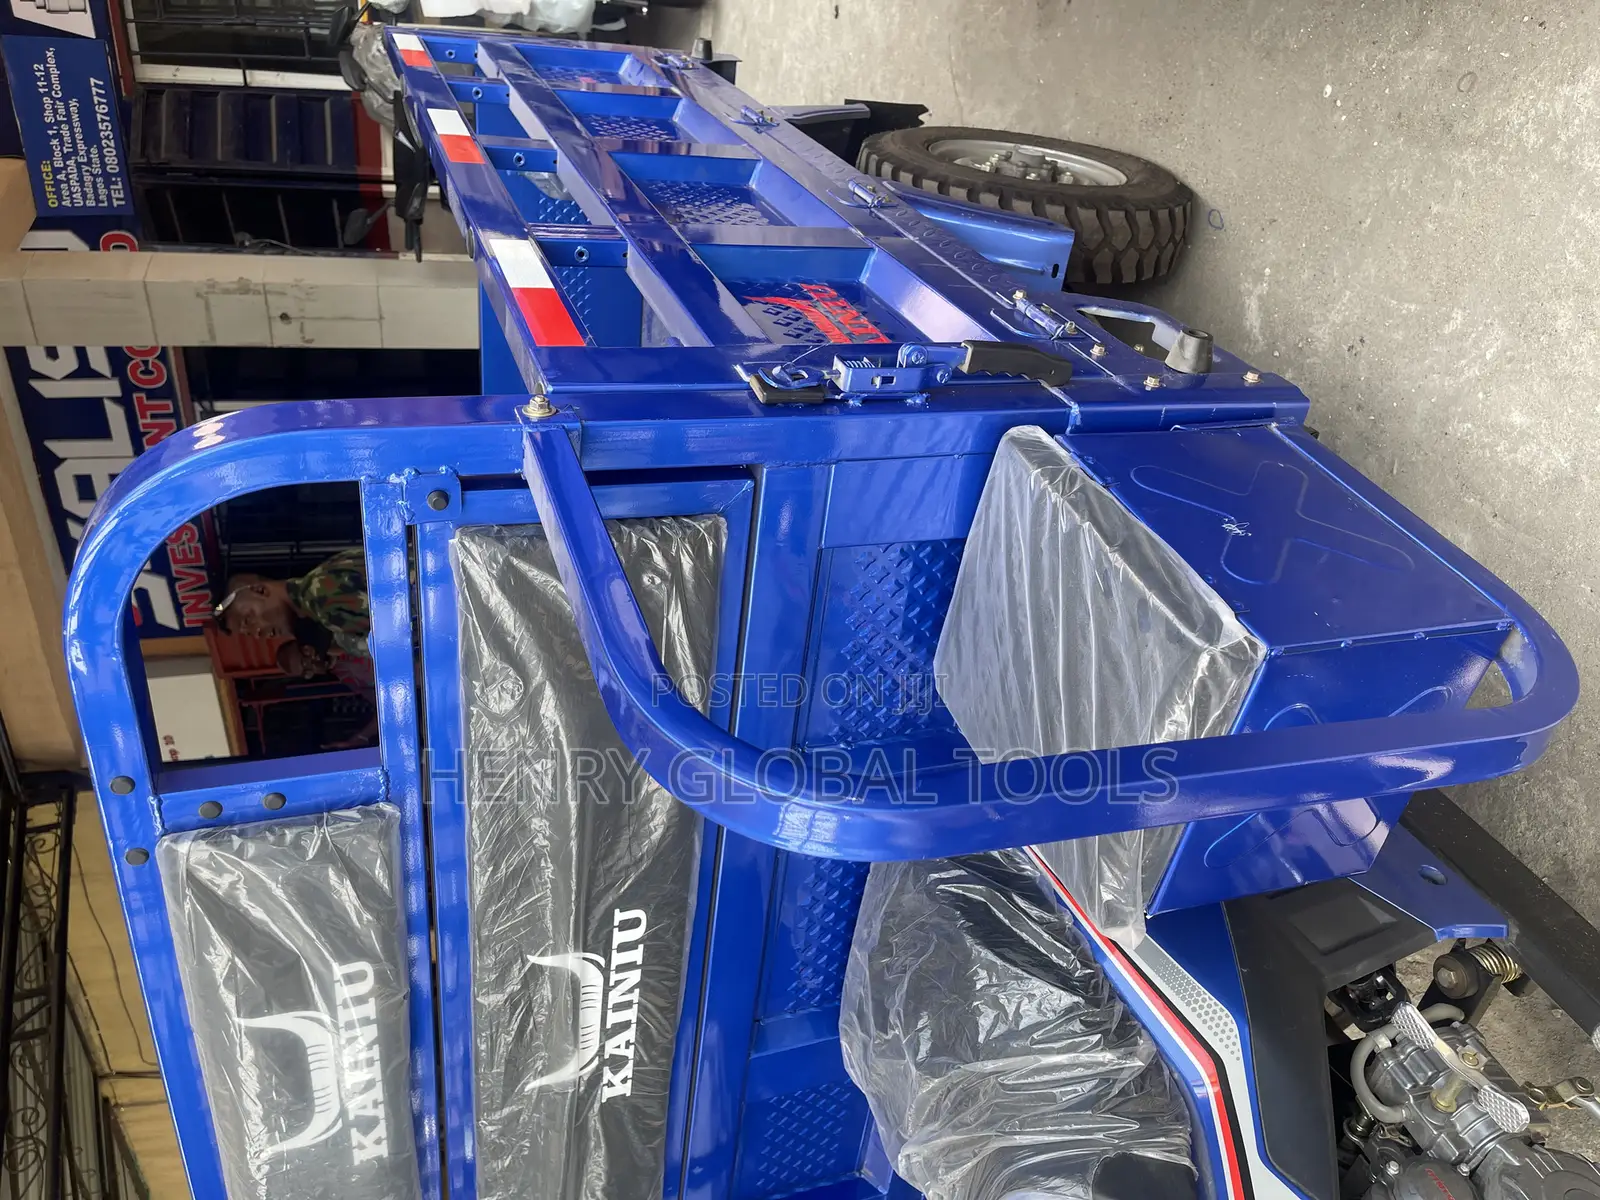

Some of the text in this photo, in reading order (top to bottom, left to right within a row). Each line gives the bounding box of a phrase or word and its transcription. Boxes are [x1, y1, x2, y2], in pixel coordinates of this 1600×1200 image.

[33, 63, 72, 207] Area A, Block 1, Shop 11-12
[45, 47, 84, 207] UASPADA, Trade Fair Complex,
[68, 98, 96, 207] Badagry Expressway,
[88, 144, 109, 207] Lagos State.
[90, 76, 120, 173] 08023576777
[40, 160, 59, 208] OFFICE:
[110, 177, 126, 208] TEL:
[601, 908, 649, 1104] KAINIU
[333, 961, 389, 1165] KAINIU
